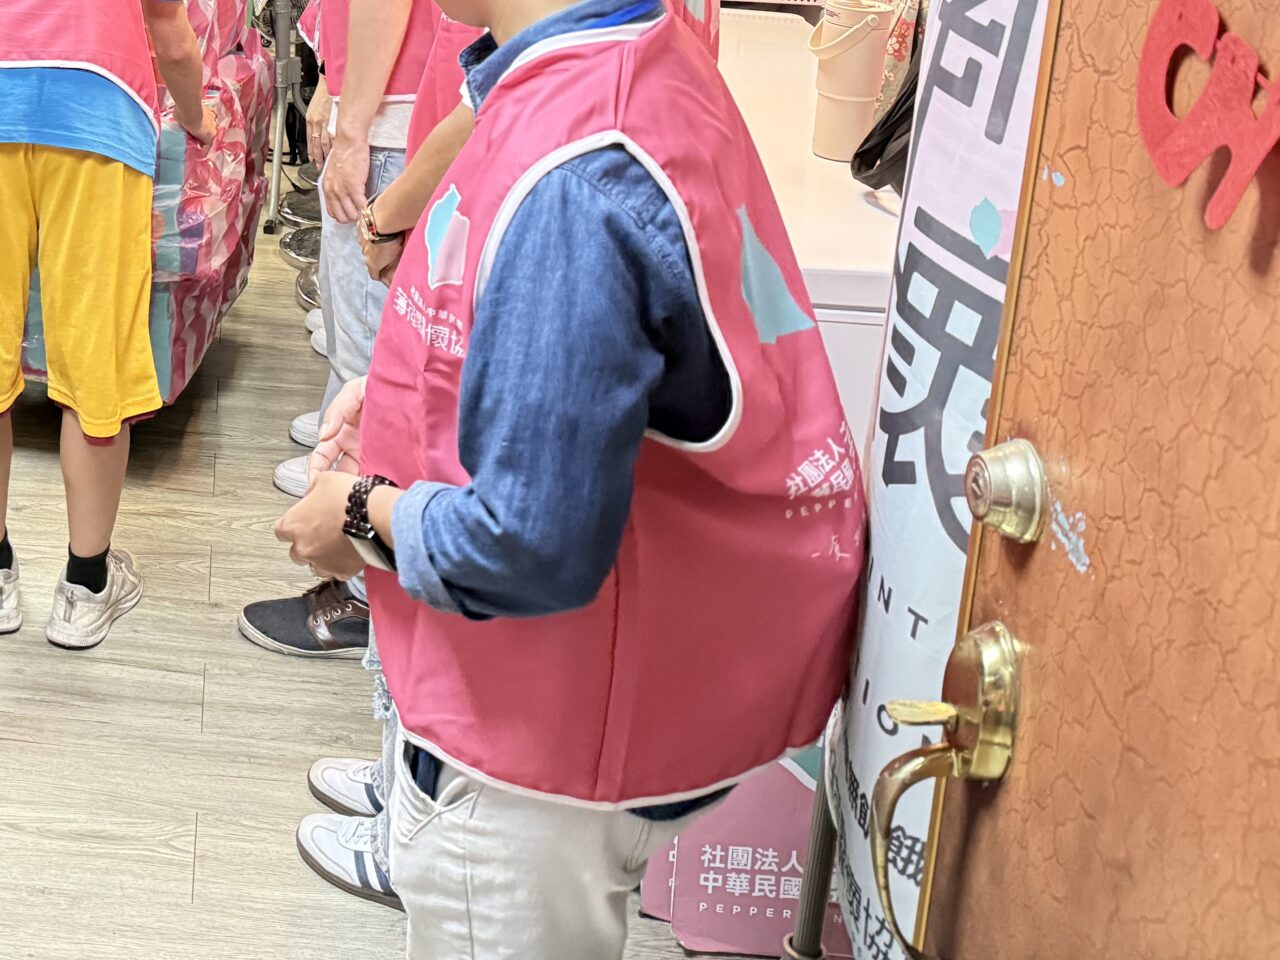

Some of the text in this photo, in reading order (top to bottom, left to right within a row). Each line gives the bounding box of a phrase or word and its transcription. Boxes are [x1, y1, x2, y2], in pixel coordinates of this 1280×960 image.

[700, 844, 804, 872] 社團法人
[699, 871, 802, 901] 中華民國
